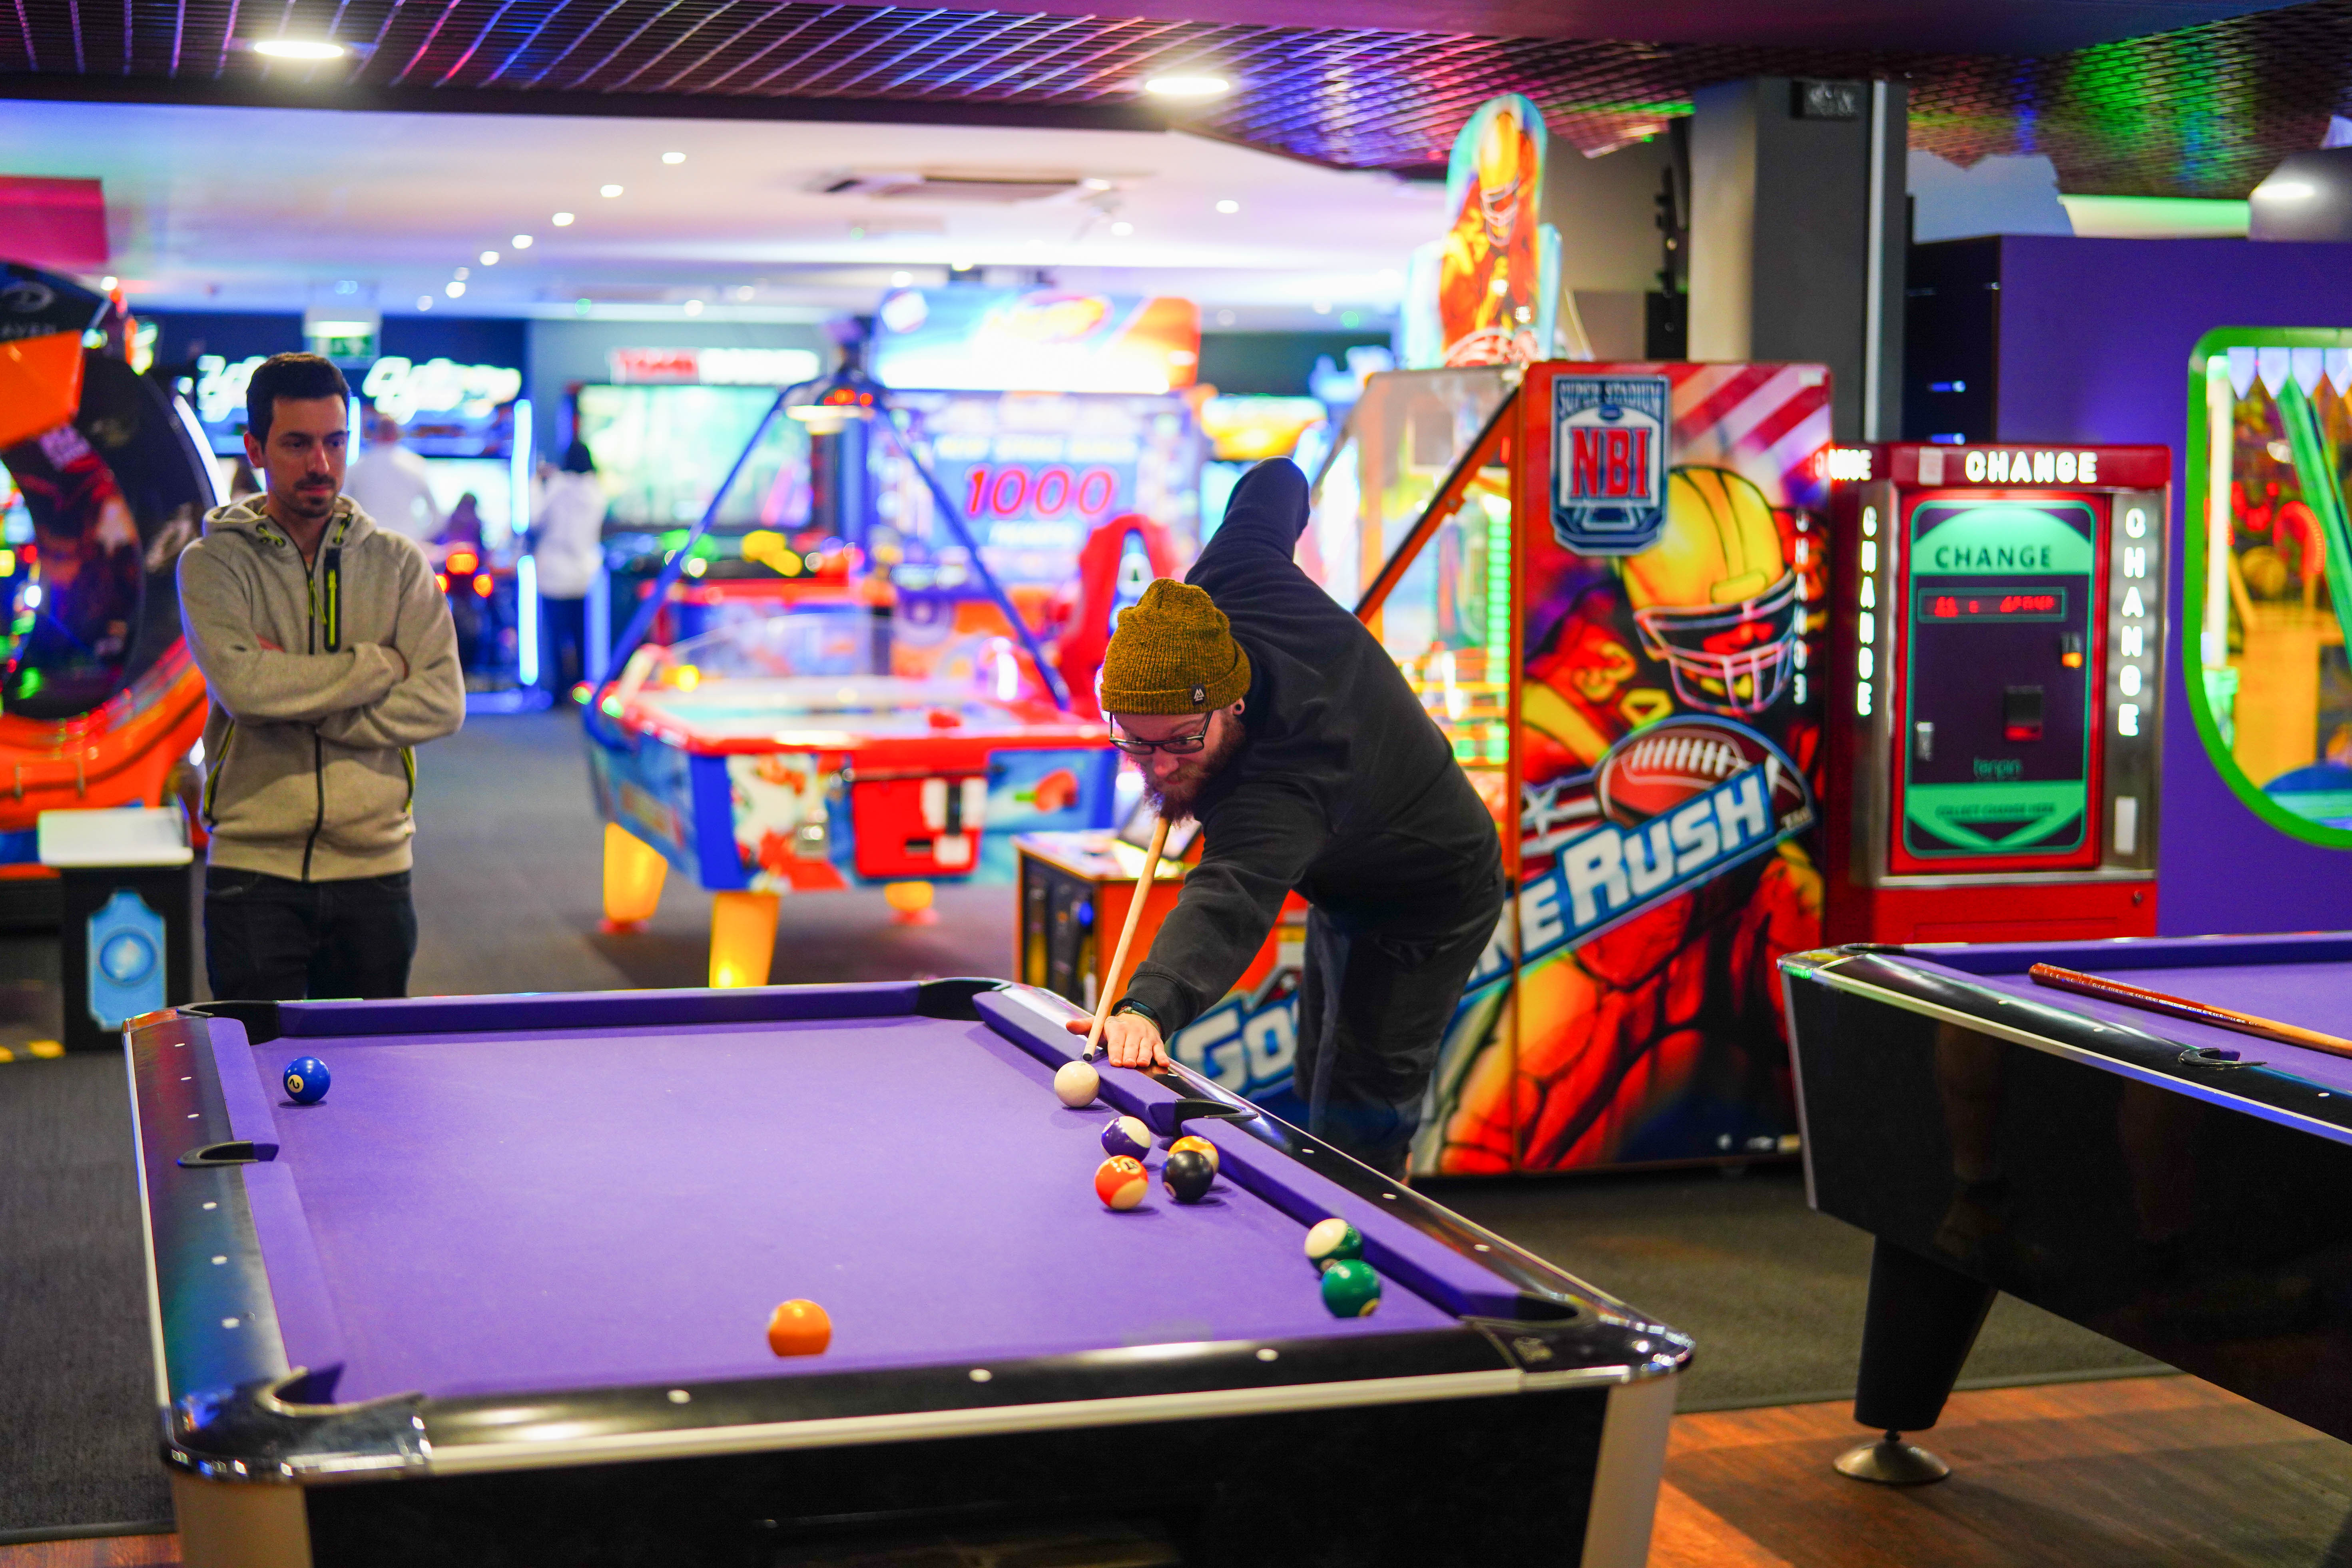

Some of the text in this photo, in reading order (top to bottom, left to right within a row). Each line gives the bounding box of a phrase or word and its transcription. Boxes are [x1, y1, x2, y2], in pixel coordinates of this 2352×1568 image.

[1559, 382, 1663, 420] SUPER STADIUM
[1570, 426, 1648, 498] NBI
[1965, 450, 2098, 484] CHANGE
[966, 467, 1114, 516] 1000
[1934, 545, 2052, 568] CHANGE
[1857, 506, 1878, 716] CHANGE
[2118, 507, 2147, 737] CHANGE
[290, 1078, 300, 1089] 2
